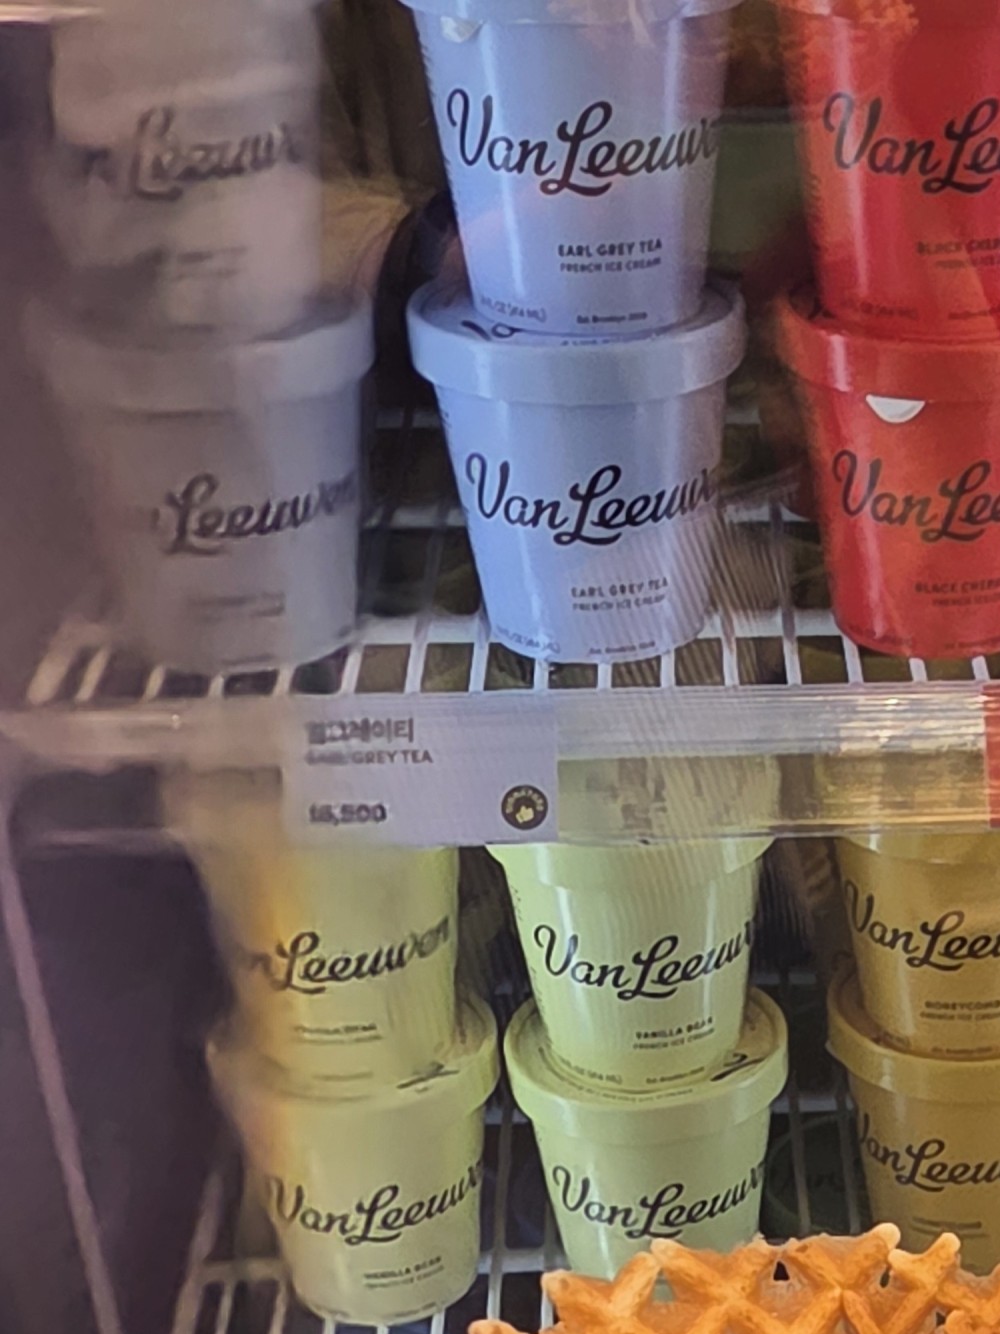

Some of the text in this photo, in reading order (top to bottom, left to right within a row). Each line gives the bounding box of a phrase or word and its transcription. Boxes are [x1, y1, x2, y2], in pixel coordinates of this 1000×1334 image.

[447, 88, 557, 176] Van
[823, 91, 941, 175] Van
[558, 238, 662, 257] EARL GREY TEA
[466, 452, 568, 529] Van
[832, 450, 938, 527] Van
[571, 586, 604, 598] EARL
[351, 750, 398, 764] GREY
[401, 749, 434, 764] TEA
[534, 924, 631, 991] Van
[552, 1165, 638, 1228] Van
